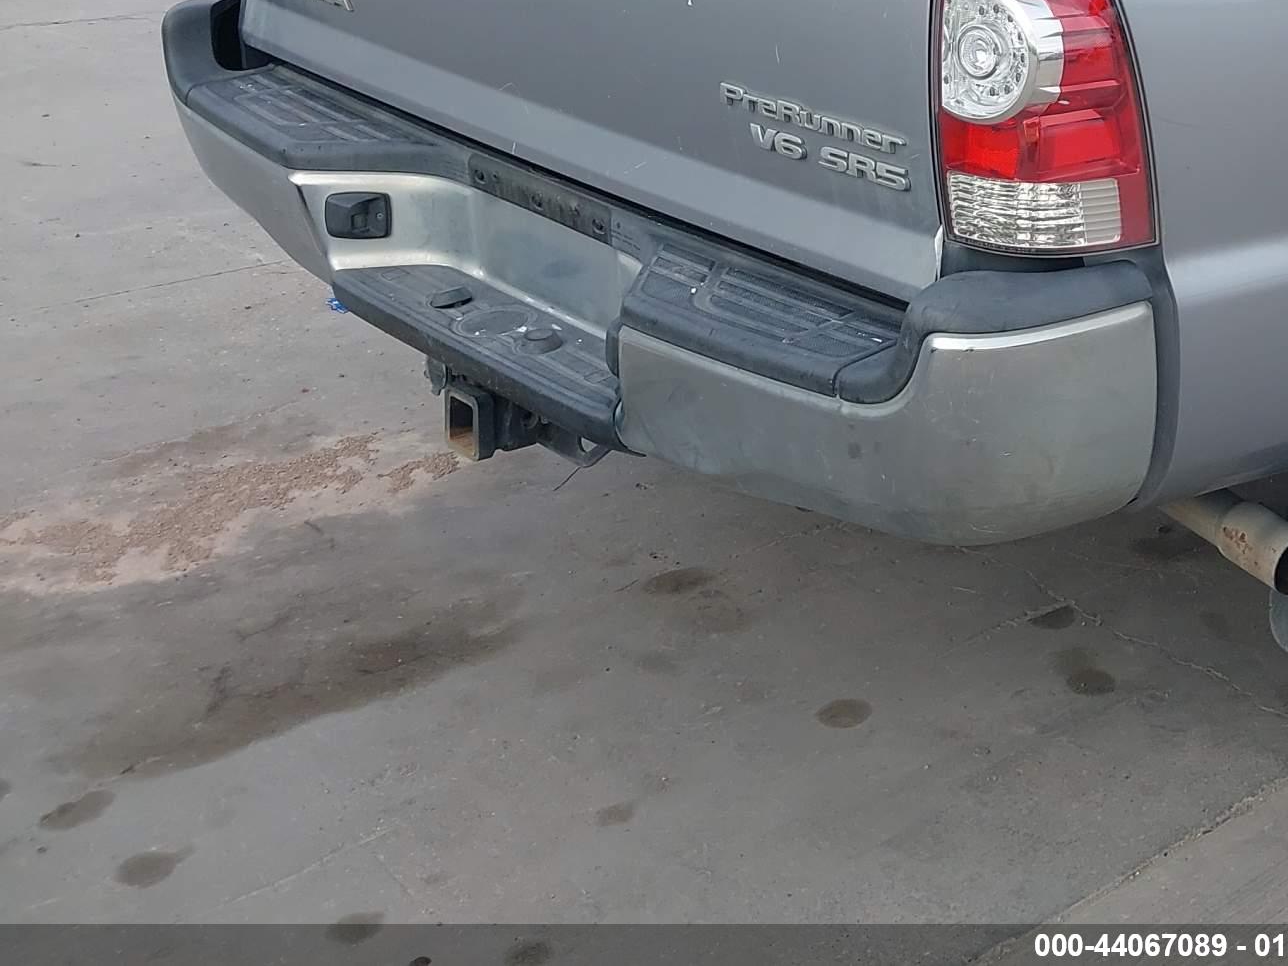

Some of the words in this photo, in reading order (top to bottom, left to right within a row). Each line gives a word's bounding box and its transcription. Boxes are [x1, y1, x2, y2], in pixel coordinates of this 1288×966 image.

[719, 81, 907, 154] PreRunner
[750, 123, 807, 160] V6
[818, 146, 911, 192] SR5
